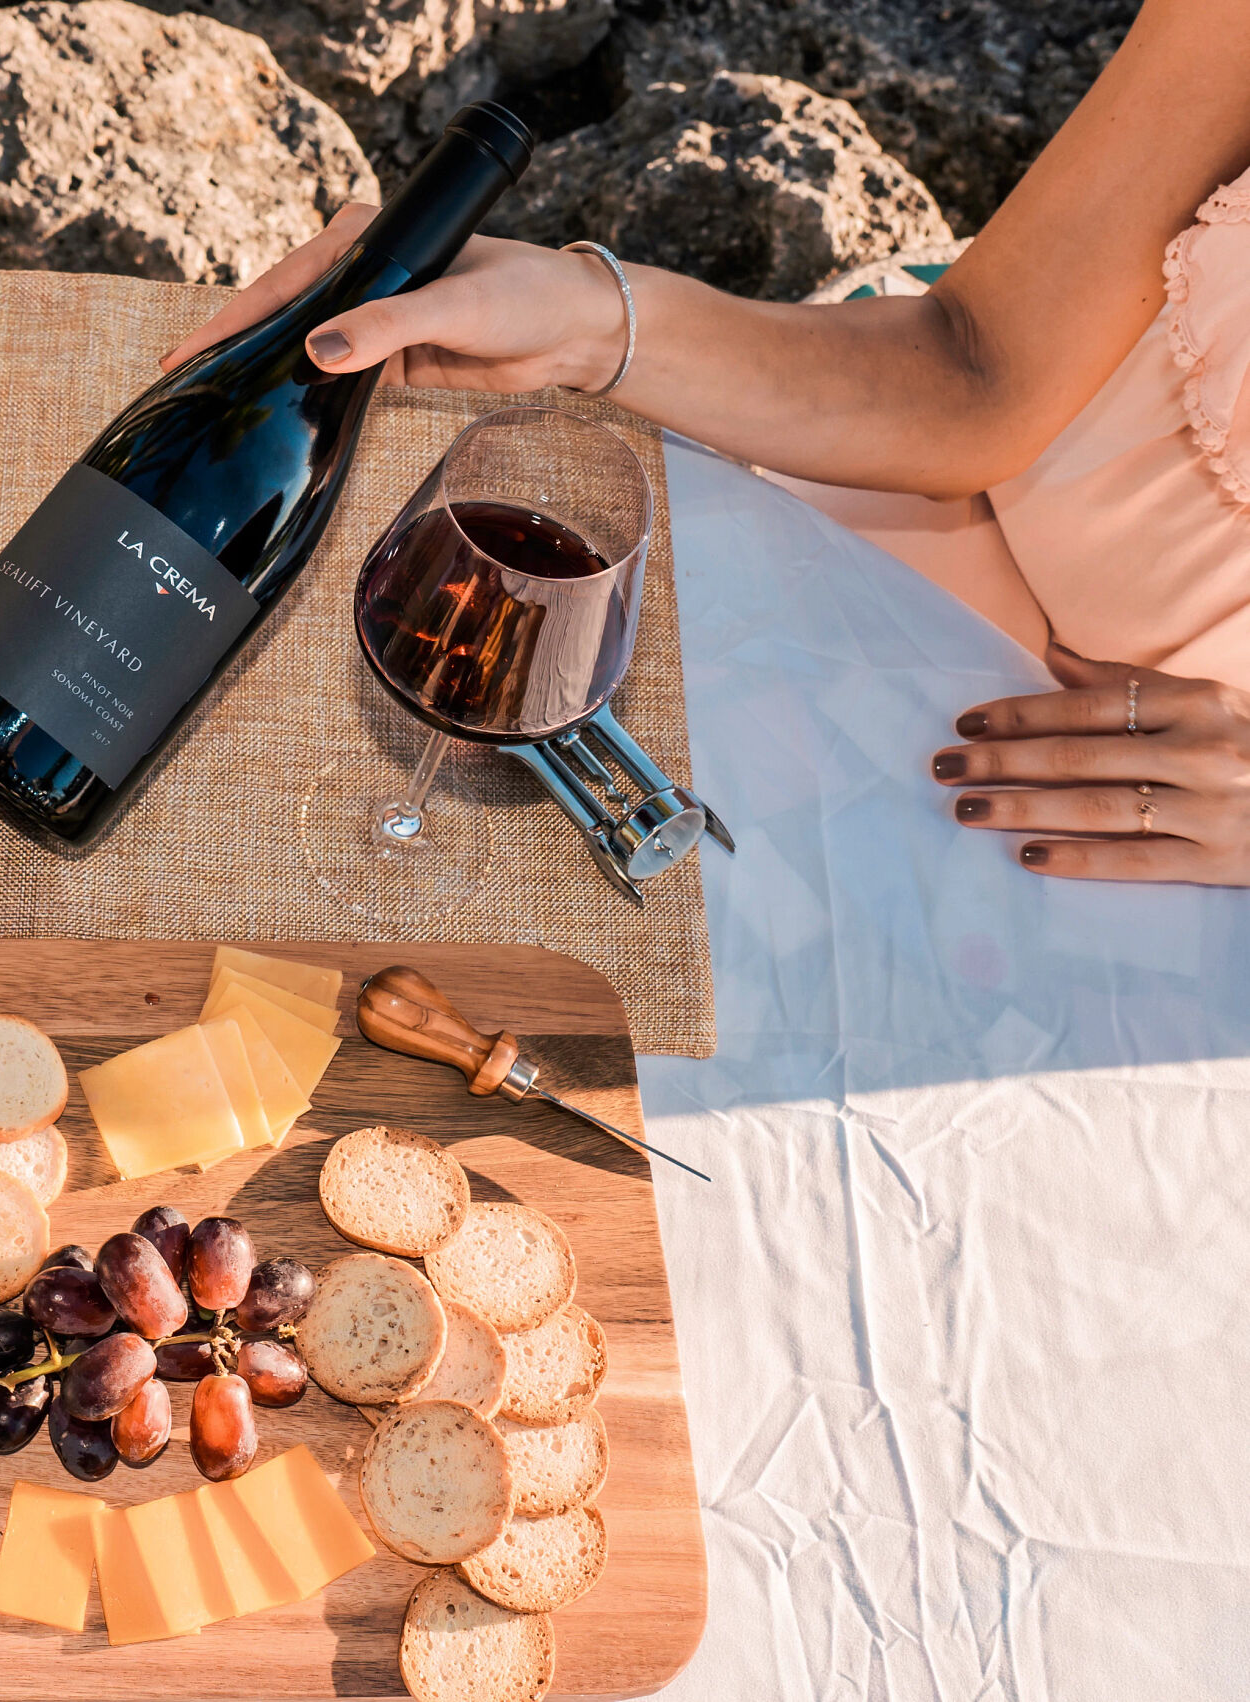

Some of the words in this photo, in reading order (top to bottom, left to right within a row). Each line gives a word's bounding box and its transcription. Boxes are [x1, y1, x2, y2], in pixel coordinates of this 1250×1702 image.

[117, 530, 143, 559] LA
[149, 555, 217, 621] CREMA
[0, 560, 52, 598] SEALIFT
[54, 595, 143, 673] VINEYARD
[51, 669, 94, 707] SONOMA
[95, 705, 125, 732] COAST
[81, 671, 112, 699] PINOT
[107, 694, 134, 720] NOIR
[91, 729, 111, 747] 2017
